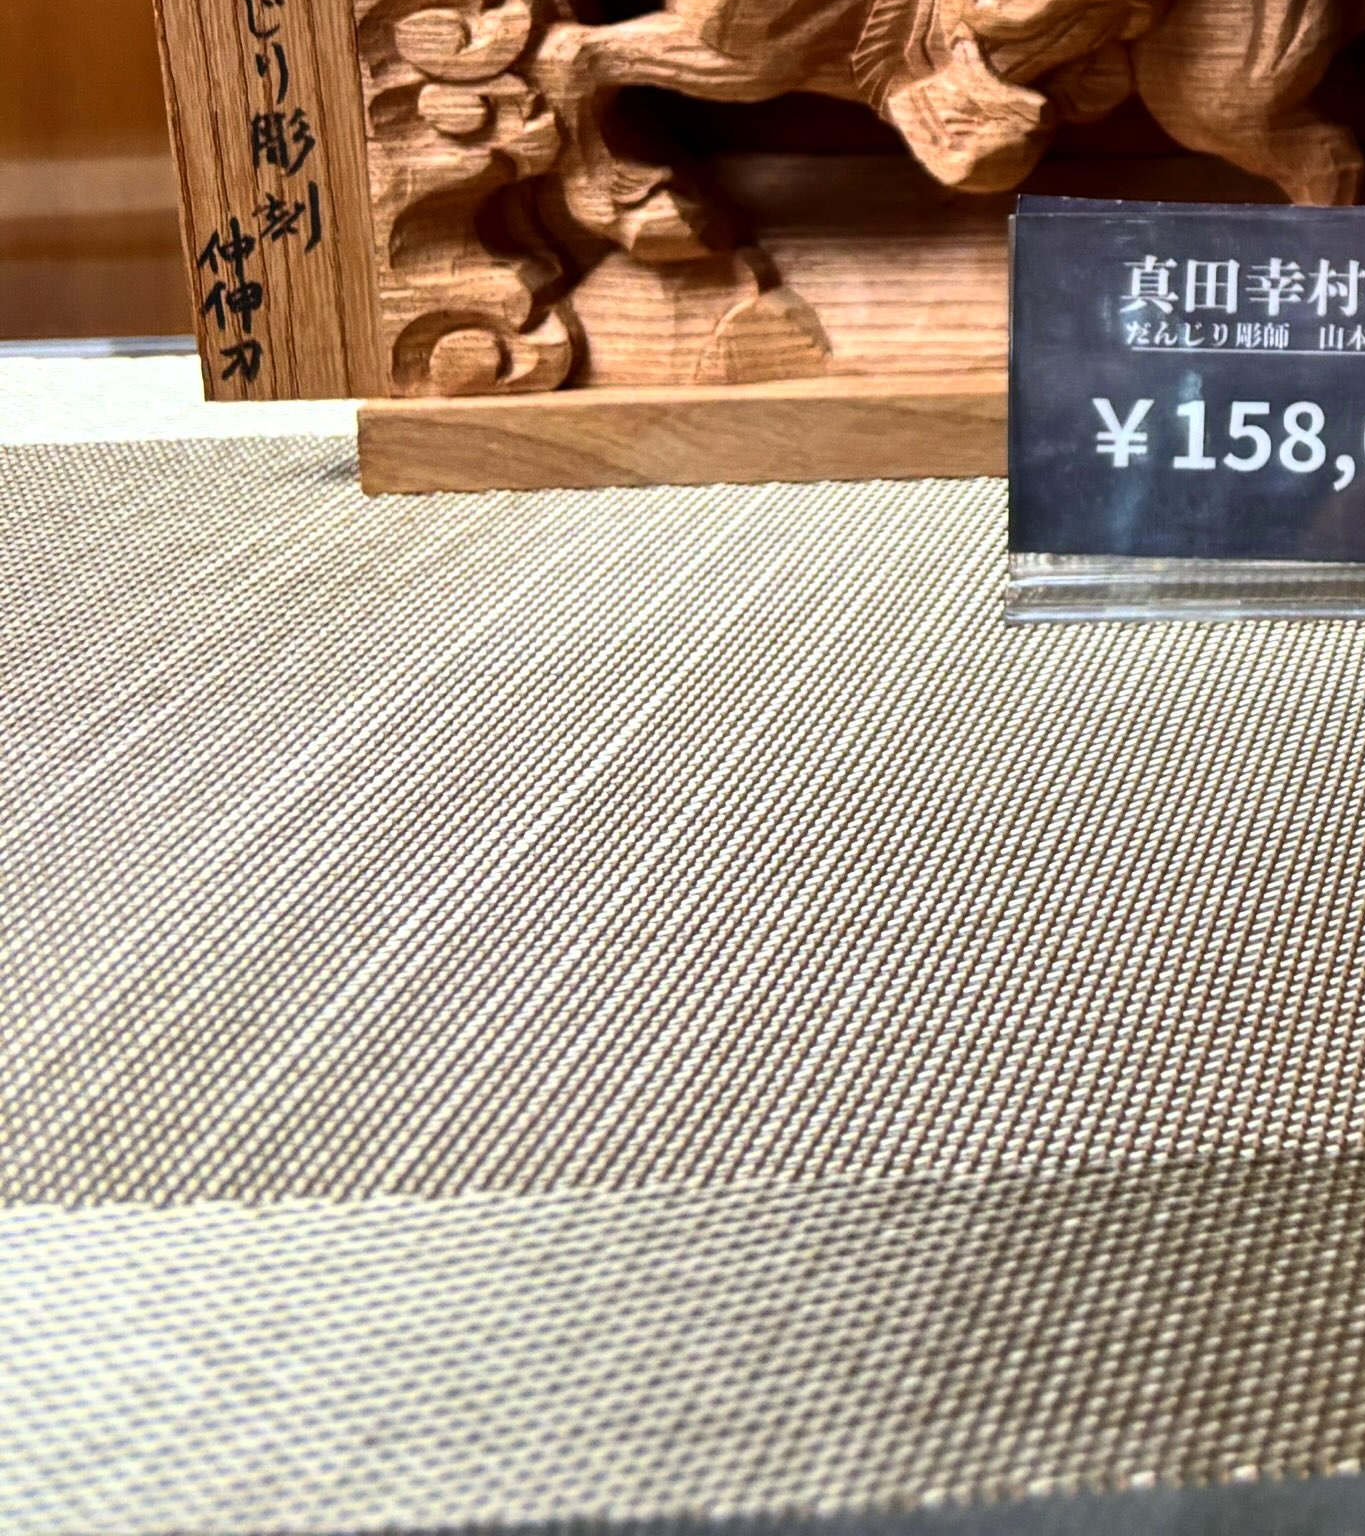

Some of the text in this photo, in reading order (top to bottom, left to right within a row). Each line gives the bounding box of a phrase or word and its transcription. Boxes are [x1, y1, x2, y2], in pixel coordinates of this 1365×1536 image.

[1126, 321, 1290, 349] だんじり彫師
